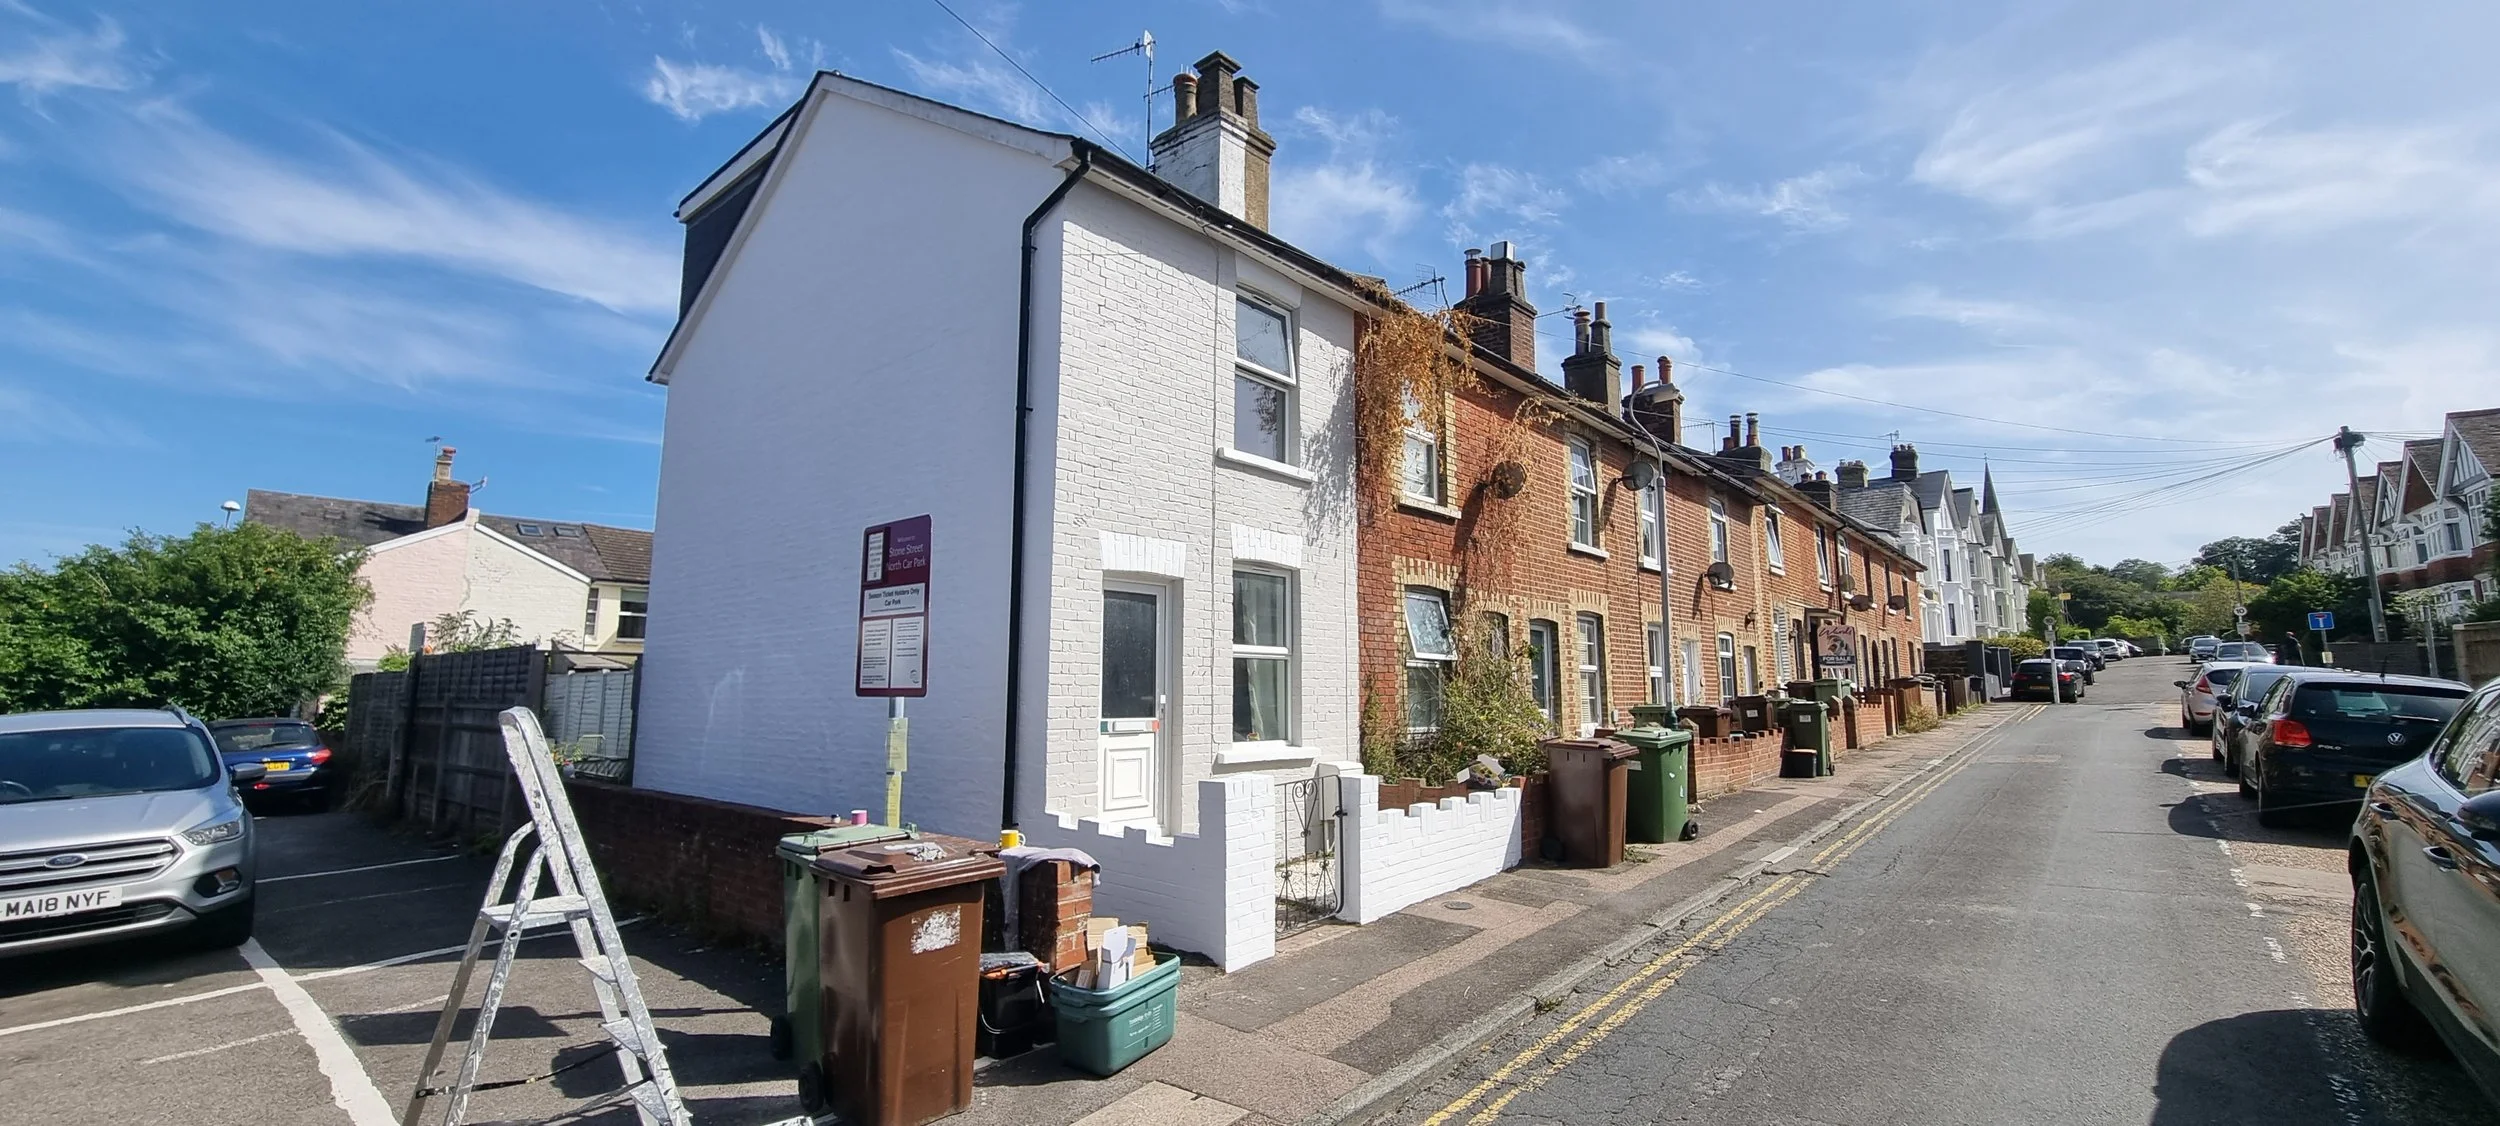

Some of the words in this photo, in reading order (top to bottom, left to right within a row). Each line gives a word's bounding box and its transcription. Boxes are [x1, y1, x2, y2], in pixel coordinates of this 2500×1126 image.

[889, 547, 905, 557] Stone
[906, 544, 924, 554] Street
[903, 558, 913, 569] Car
[914, 556, 926, 567] Park
[910, 588, 920, 596] Only
[5, 897, 59, 917] MA18
[66, 890, 111, 910] NYF
